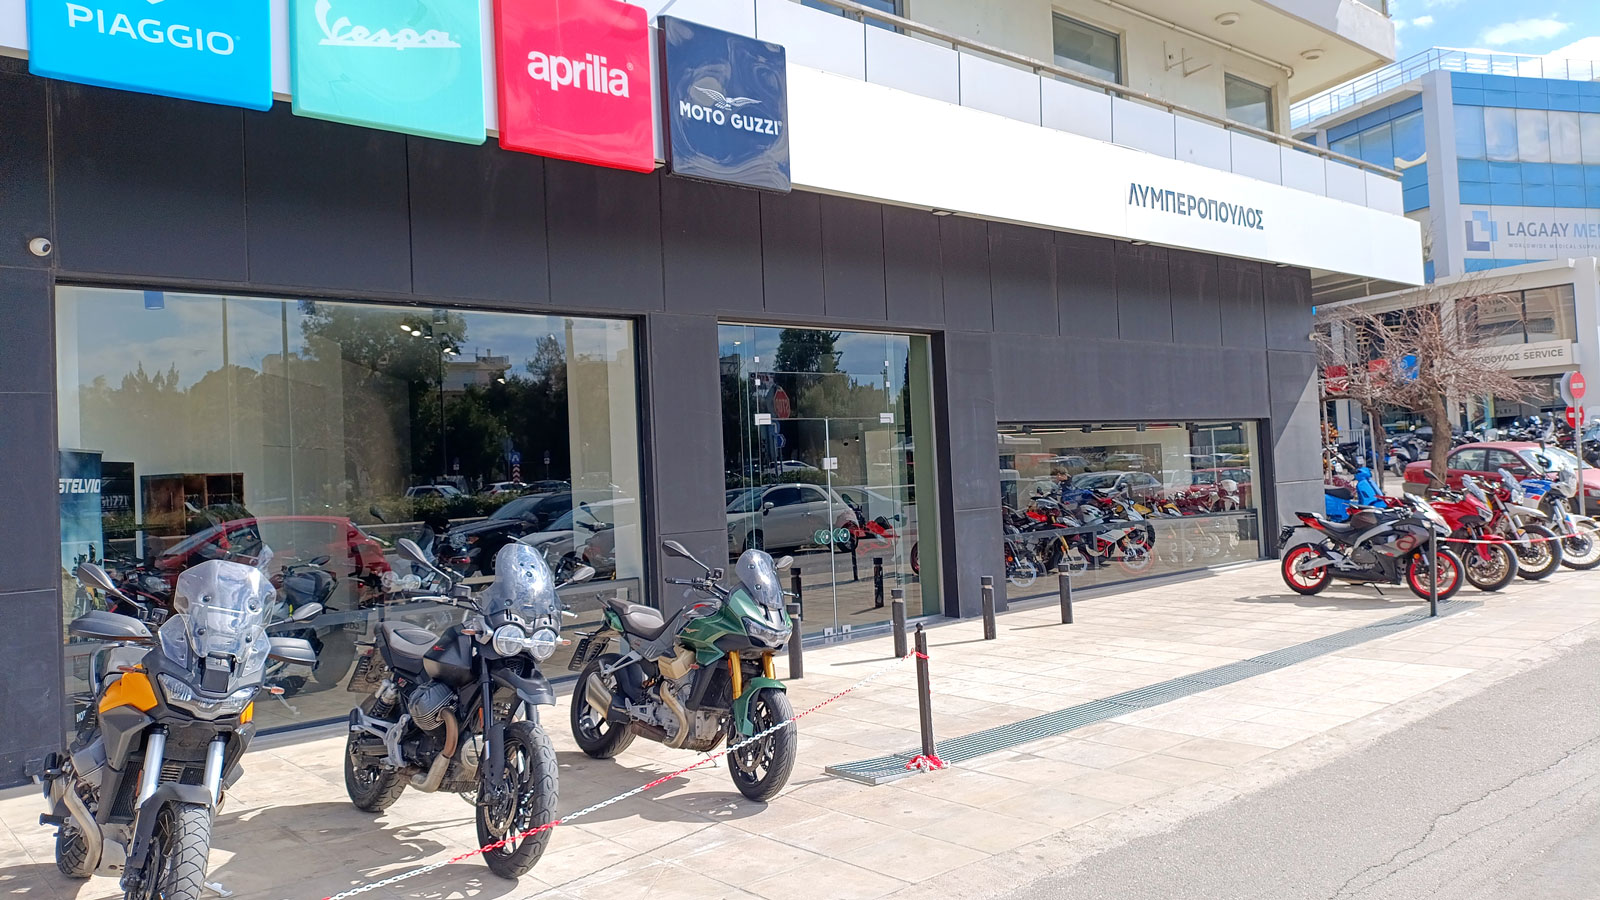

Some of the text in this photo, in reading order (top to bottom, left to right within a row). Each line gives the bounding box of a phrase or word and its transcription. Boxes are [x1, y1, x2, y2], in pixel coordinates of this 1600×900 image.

[66, 2, 235, 55] PIAGGIO
[315, 0, 461, 50] Vespa
[527, 50, 630, 98] aprilia
[679, 100, 779, 136] MOTO GUZZI
[1128, 182, 1264, 231] ΛΥΜΠΕΡΟΠΟΥΛΟΣ
[1506, 221, 1569, 238] LAGAAY
[1507, 242, 1547, 250] WORLDWIDE
[1523, 348, 1564, 360] SERVICE
[58, 478, 101, 494] STELVIO
